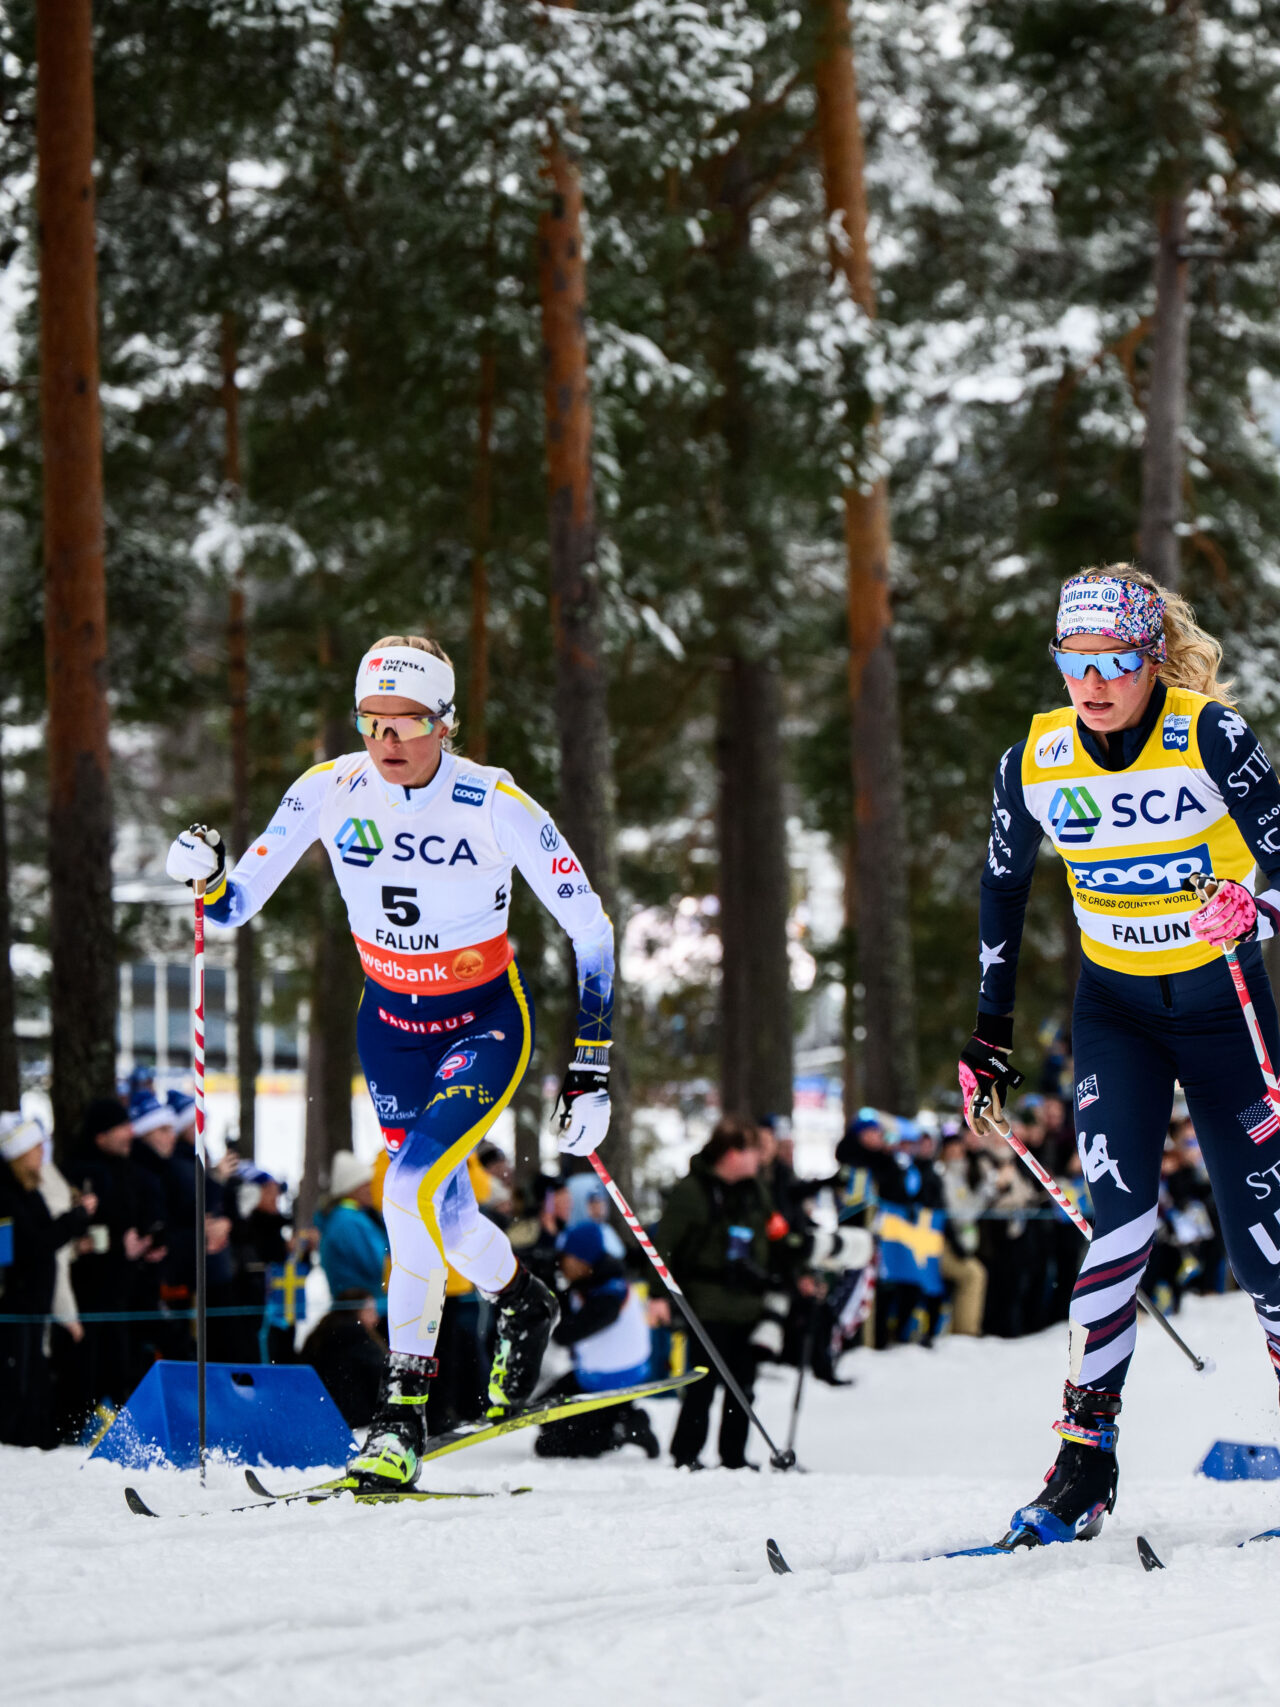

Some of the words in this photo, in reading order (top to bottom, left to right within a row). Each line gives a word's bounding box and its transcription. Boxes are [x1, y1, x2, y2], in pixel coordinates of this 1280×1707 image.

[382, 665, 403, 673] SPEL
[385, 659, 425, 673] SVENSKA
[453, 787, 484, 802] coop
[1112, 786, 1207, 828] SCA
[391, 832, 478, 866] SCA
[552, 857, 580, 875] ICA
[381, 885, 421, 927] 5
[1077, 891, 1087, 903] FIS
[1088, 894, 1117, 908] CROSS
[375, 928, 439, 951] FALUN
[1112, 920, 1192, 945] FALUN
[379, 1006, 476, 1035] BAUHAUS
[1077, 1074, 1096, 1093] US
